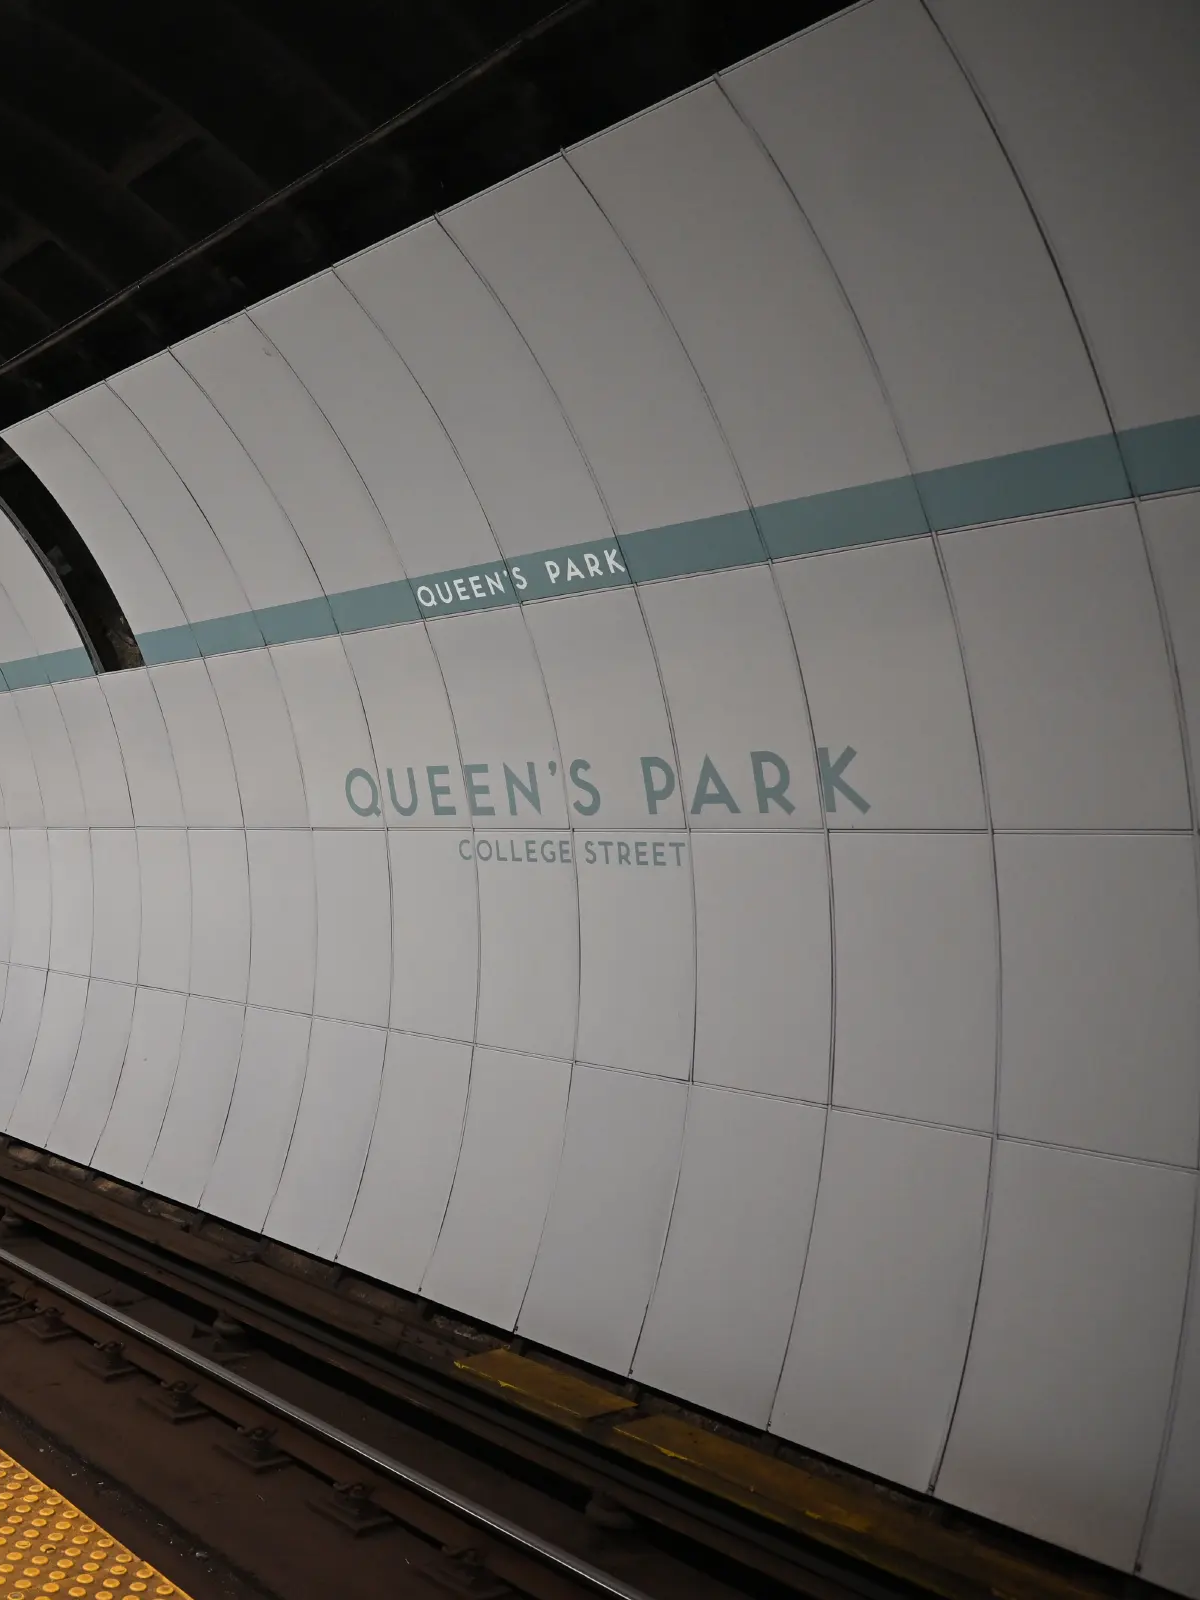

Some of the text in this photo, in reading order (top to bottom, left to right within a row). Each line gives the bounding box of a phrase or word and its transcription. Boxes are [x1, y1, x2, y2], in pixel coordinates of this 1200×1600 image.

[416, 548, 626, 607] QUEEN'S PARK
[345, 745, 872, 818] QUEEN'S PARK
[458, 839, 686, 866] COLLEGE STREET
